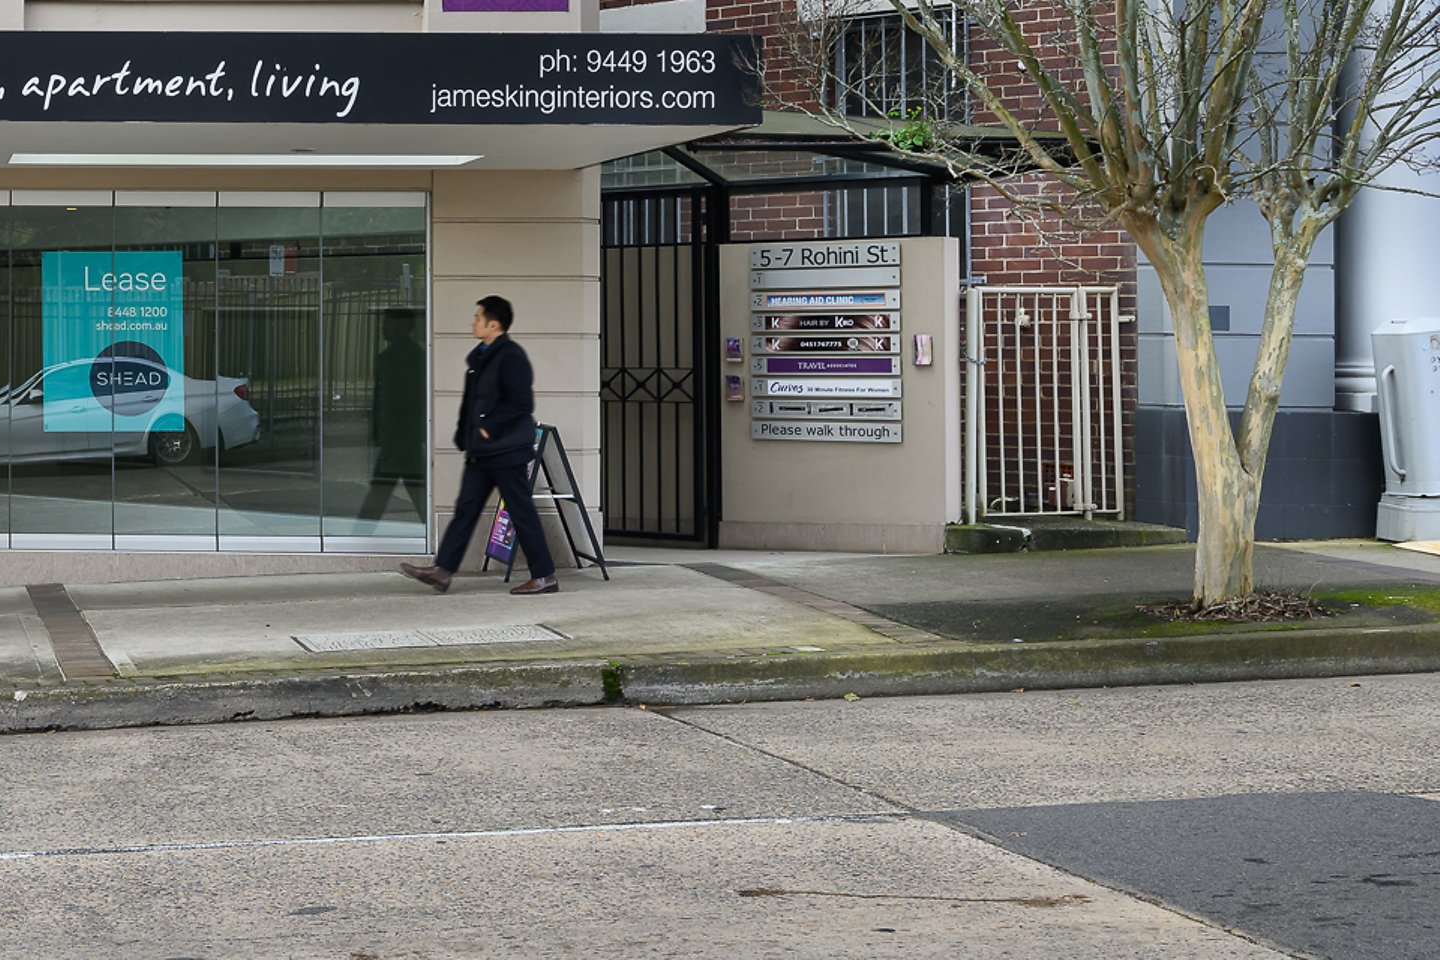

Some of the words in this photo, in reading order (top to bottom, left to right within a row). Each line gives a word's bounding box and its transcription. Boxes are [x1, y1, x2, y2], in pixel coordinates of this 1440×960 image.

[539, 49, 577, 78] ph:
[587, 50, 647, 73] 9449
[656, 50, 716, 73] 1963
[22, 60, 234, 110] apartment,
[250, 60, 361, 117] living
[430, 84, 715, 114] jameskinginteriors.com
[760, 248, 794, 267] 5-7
[801, 246, 859, 266] Rohini
[867, 245, 889, 264] St
[84, 266, 167, 291] Lease
[771, 296, 809, 306] HEARING
[810, 296, 824, 305] AID
[825, 296, 854, 305] CLINIC
[140, 306, 168, 317] 1200
[96, 321, 168, 331] shead.com.au
[798, 362, 826, 370] TRAVEL
[96, 371, 161, 386] SHEAD
[770, 382, 804, 394] Curves
[761, 424, 802, 436] Please
[806, 425, 835, 437] walk
[839, 425, 890, 440] through
